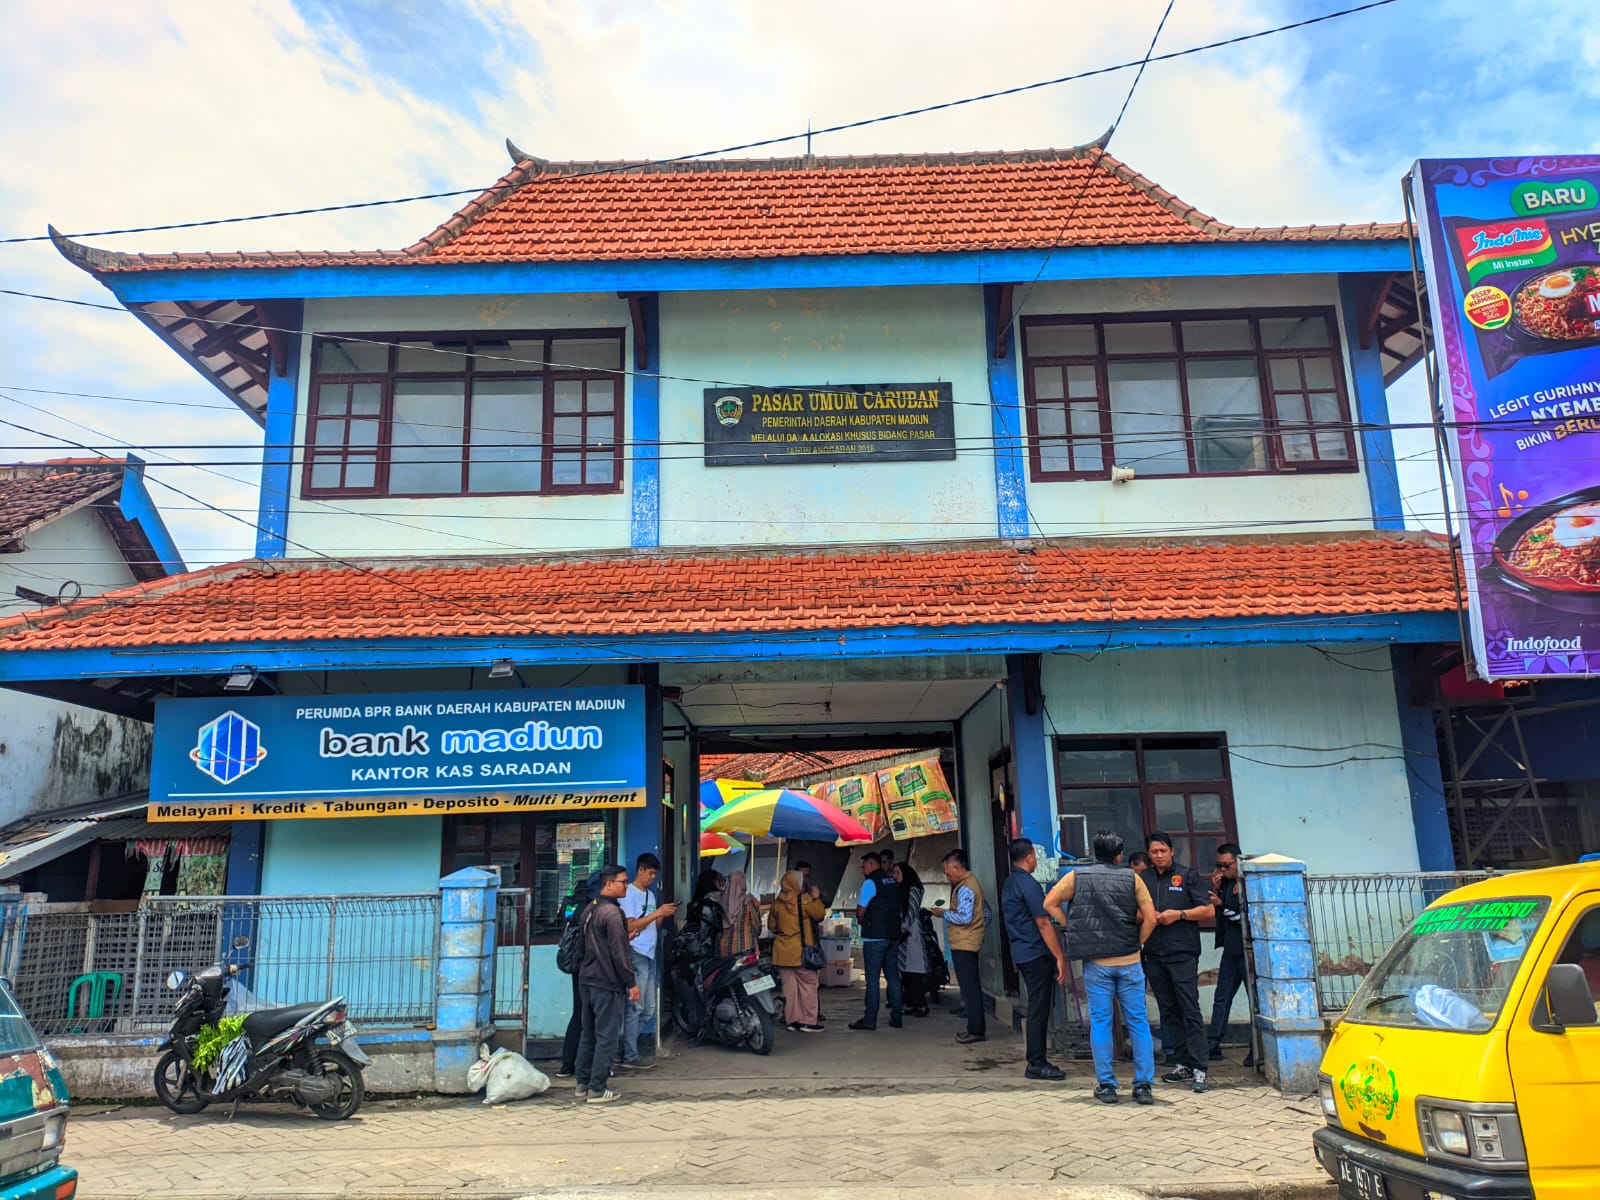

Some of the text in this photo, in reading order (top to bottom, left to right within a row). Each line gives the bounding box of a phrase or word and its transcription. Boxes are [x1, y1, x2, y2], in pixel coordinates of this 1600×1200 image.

[1523, 188, 1587, 210] BARU
[1493, 258, 1534, 270] Mi Instan
[752, 389, 939, 412] PASAR UMUM CARUBAN
[1489, 395, 1530, 419] LEGIT
[762, 413, 929, 428] PEMERINTAH DAERAH KABUPATEN MADIUN
[751, 433, 785, 442] MELALUI
[810, 431, 843, 441] ALOKASI
[844, 430, 877, 440] KHUSUS
[878, 430, 908, 439] BIDANG
[909, 429, 936, 439] PASAR
[1515, 430, 1552, 451] BIKIN
[1506, 635, 1581, 656] Indofood
[296, 699, 625, 720] PERUMDA BPR BANK DAERAH KABUPATEN MADIUN
[320, 720, 602, 760] bank madiun
[351, 761, 571, 781] KANTOR KAS SARADAN
[157, 791, 637, 818] Melayani Kredit Tabungan Deposito Multi Payment
